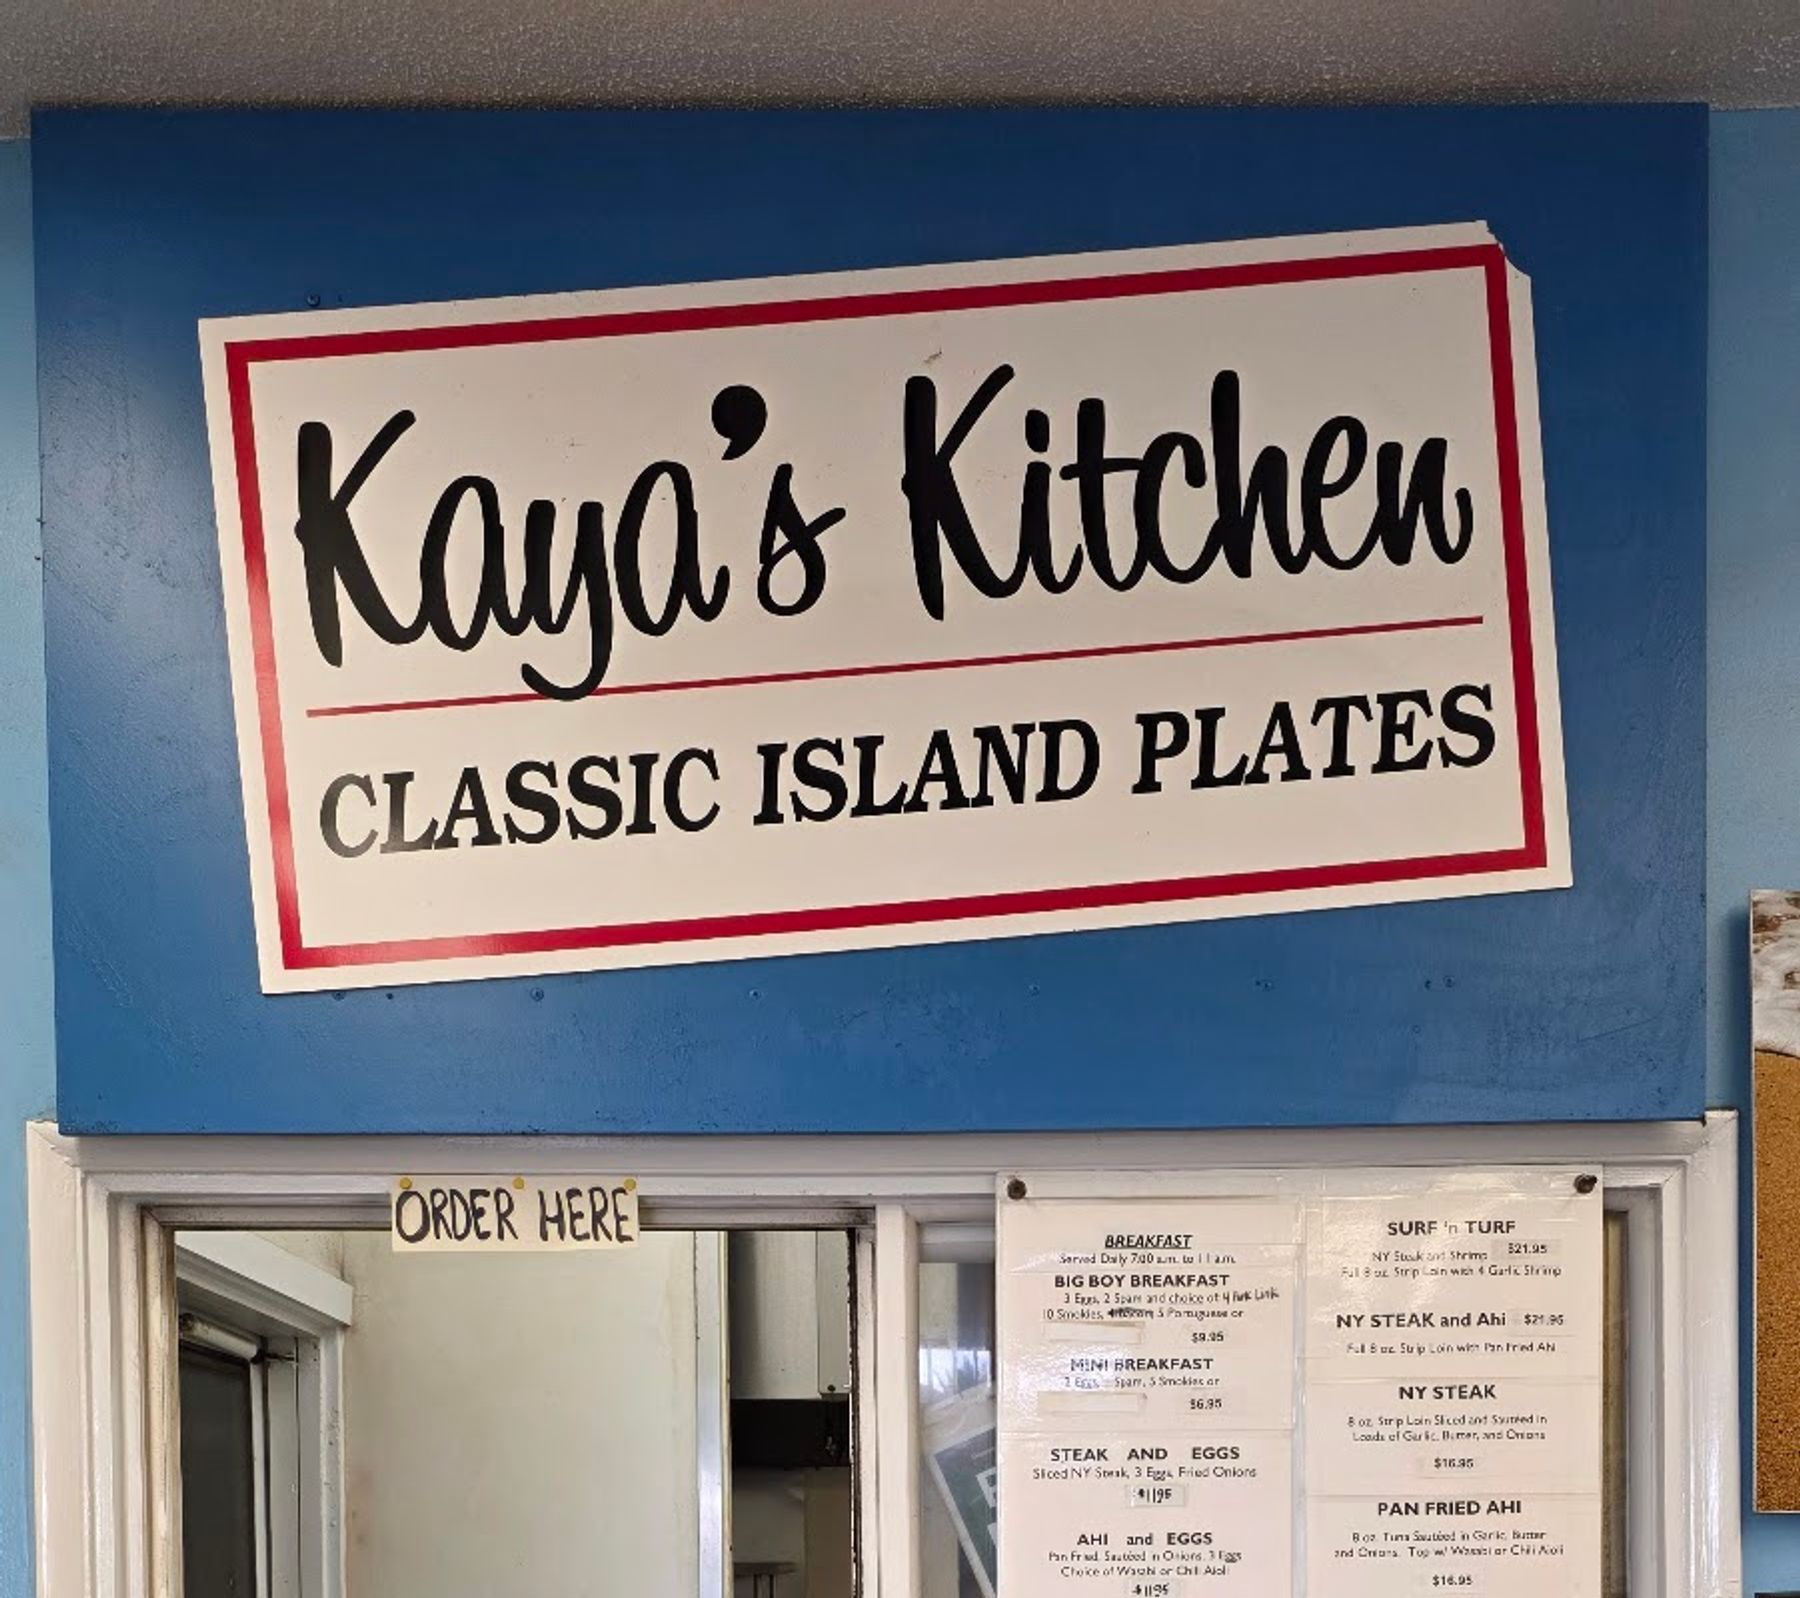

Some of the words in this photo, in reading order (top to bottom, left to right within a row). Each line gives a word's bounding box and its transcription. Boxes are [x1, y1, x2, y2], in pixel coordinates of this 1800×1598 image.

[295, 385, 845, 701] Kaya's
[902, 364, 1474, 621] Kitchen
[318, 748, 722, 857] CLASSIC
[753, 718, 1101, 824] ISLAND
[1131, 683, 1496, 794] PLATES
[395, 1188, 518, 1243] ORDER
[538, 1187, 634, 1243] HERE
[1388, 1221, 1437, 1235] SURF
[1465, 1221, 1515, 1233] TURF
[1105, 1235, 1192, 1249] BREAKFAST
[1509, 1243, 1547, 1254] $21.95
[1055, 1275, 1084, 1287] BIG
[1089, 1275, 1125, 1287] BOY
[1131, 1275, 1229, 1287] BREAKFAST
[1337, 1315, 1364, 1328] NY
[1371, 1313, 1435, 1327] STEAK
[1441, 1313, 1471, 1327] and
[1477, 1313, 1505, 1326] Ahi
[1525, 1314, 1563, 1325] $21.95
[1115, 1359, 1213, 1371] BREAKFAST
[1399, 1387, 1427, 1399] NY
[1433, 1385, 1496, 1399] STEAK
[1051, 1449, 1108, 1463] STEAK
[1127, 1448, 1167, 1460] AND
[1192, 1447, 1239, 1459] EGGS
[1071, 1467, 1091, 1478] NY
[1135, 1466, 1142, 1477] 3
[1213, 1467, 1256, 1477] Onions
[1379, 1503, 1419, 1515] PAN
[1426, 1501, 1480, 1515] FRIED
[1487, 1501, 1521, 1514] AHI
[1077, 1534, 1107, 1545] AHI
[1127, 1533, 1152, 1545] and
[1167, 1533, 1212, 1545] EGGS
